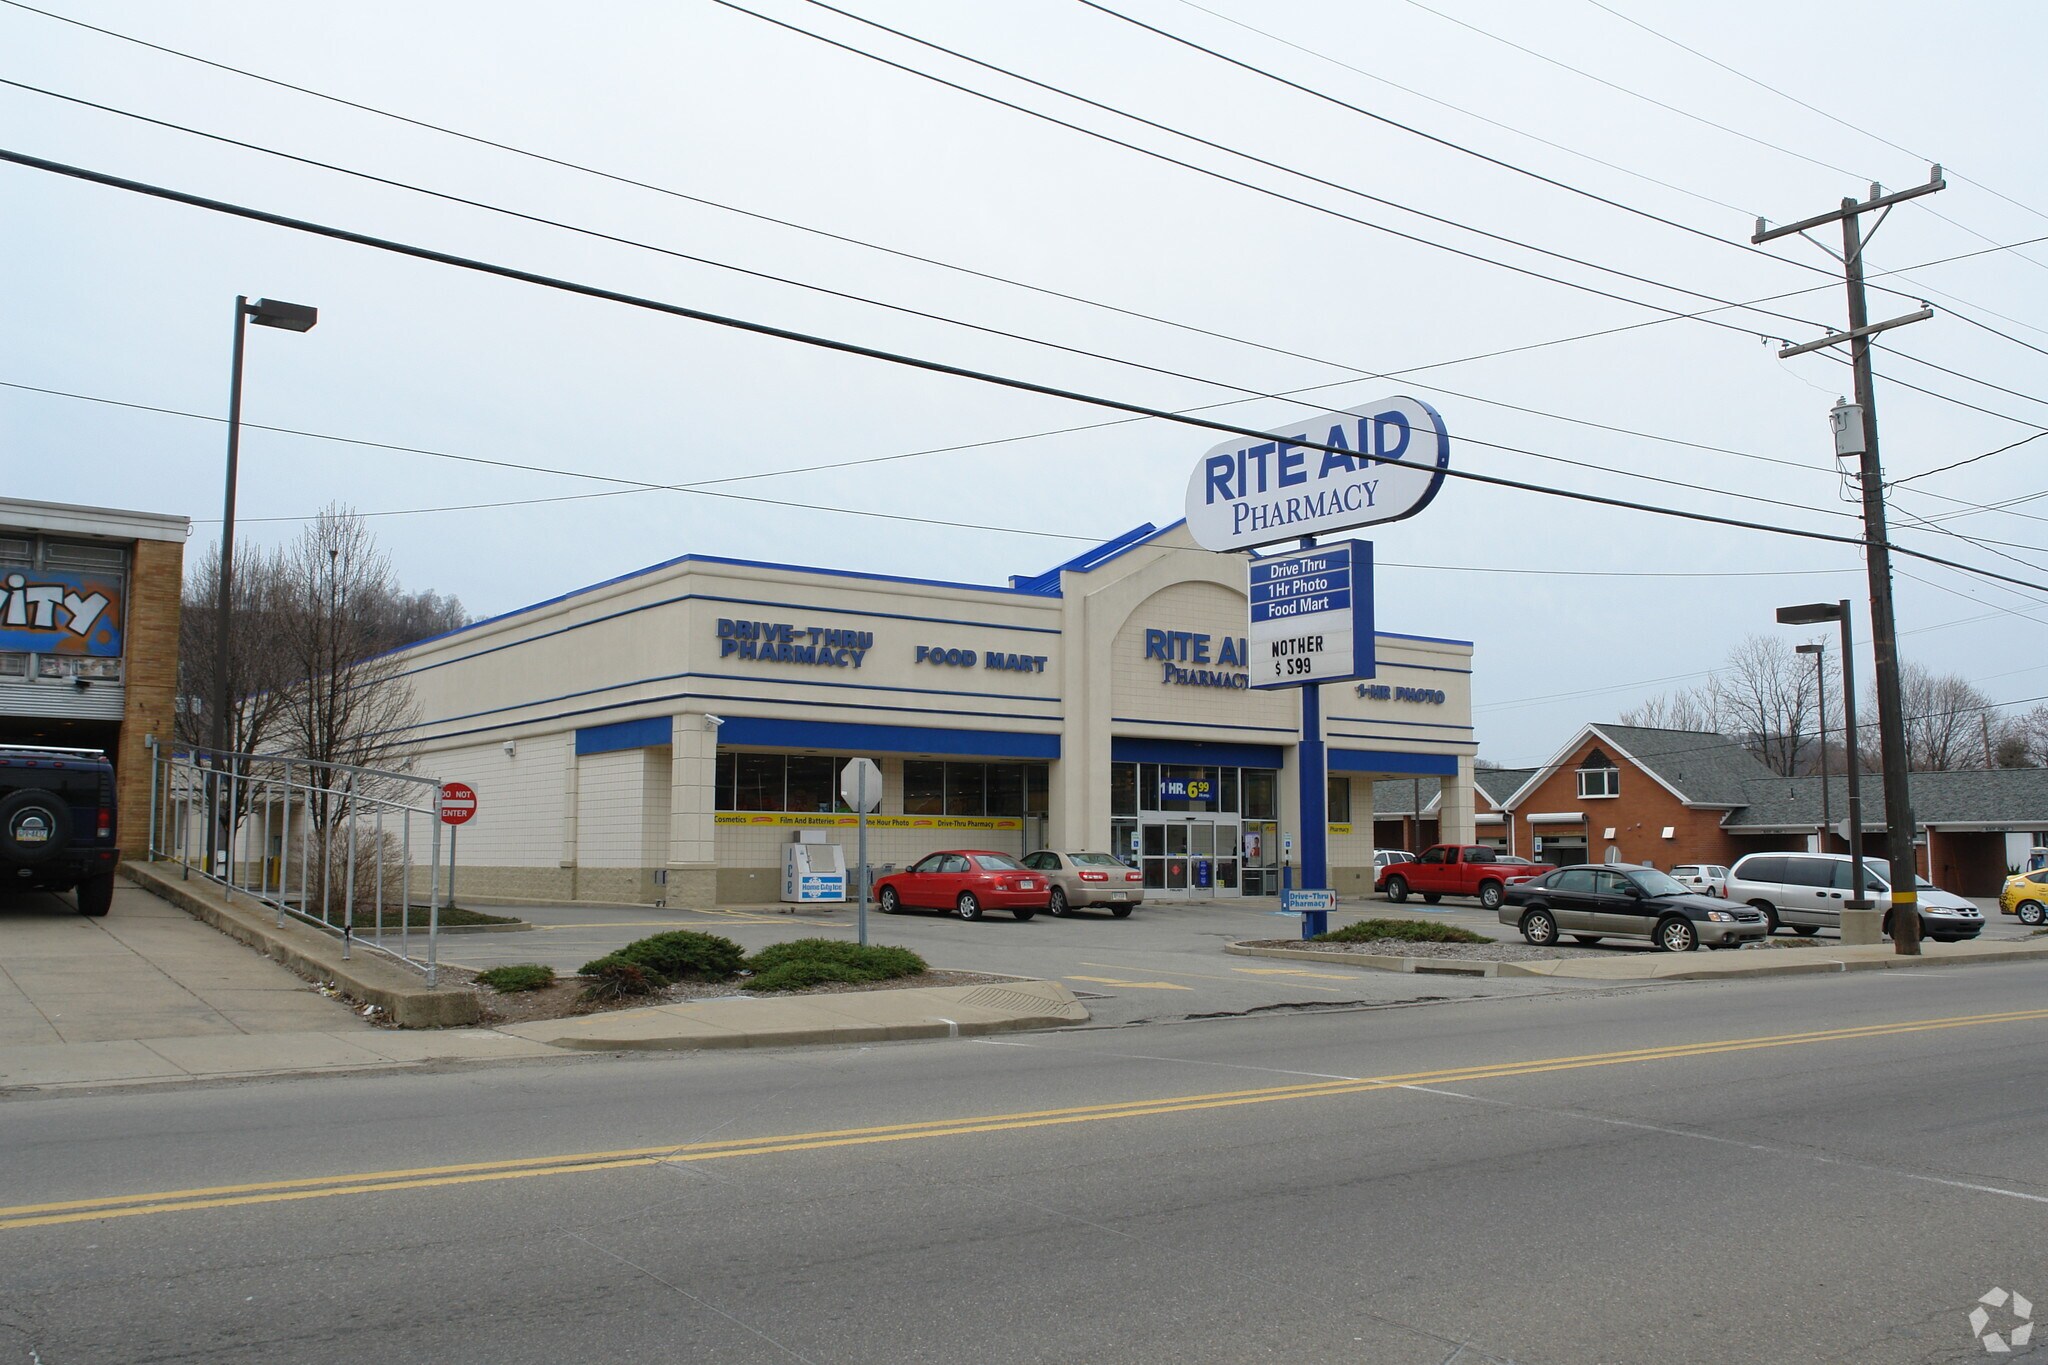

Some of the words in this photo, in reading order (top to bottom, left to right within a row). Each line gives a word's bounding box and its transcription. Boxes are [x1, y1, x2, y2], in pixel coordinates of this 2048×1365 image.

[1206, 433, 1308, 505] RITE
[1318, 410, 1411, 480] AID
[1232, 479, 1380, 536] PHARMACY
[1270, 563, 1299, 579] Drive
[1300, 558, 1327, 573] Thru
[1276, 582, 1290, 597] Hr
[1293, 578, 1328, 594] Photo
[1268, 600, 1297, 617] Food
[1300, 596, 1329, 613] Mart
[716, 617, 874, 650] DRIVE-THRU
[719, 638, 867, 668] PHARMACY
[1144, 628, 1211, 664] RITE
[1216, 635, 1249, 668] AI
[1271, 635, 1323, 658] NOTHER
[915, 645, 978, 668] FOOD
[984, 651, 1048, 673] MART
[1393, 686, 1446, 706] PHOTO
[780, 816, 793, 824] Film
[808, 817, 835, 825] Batteries
[937, 820, 966, 828] Drive-Thru
[967, 820, 994, 829] Pharmacy
[1289, 892, 1329, 900] Drive-Thru
[1289, 900, 1326, 908] Pharmacy
